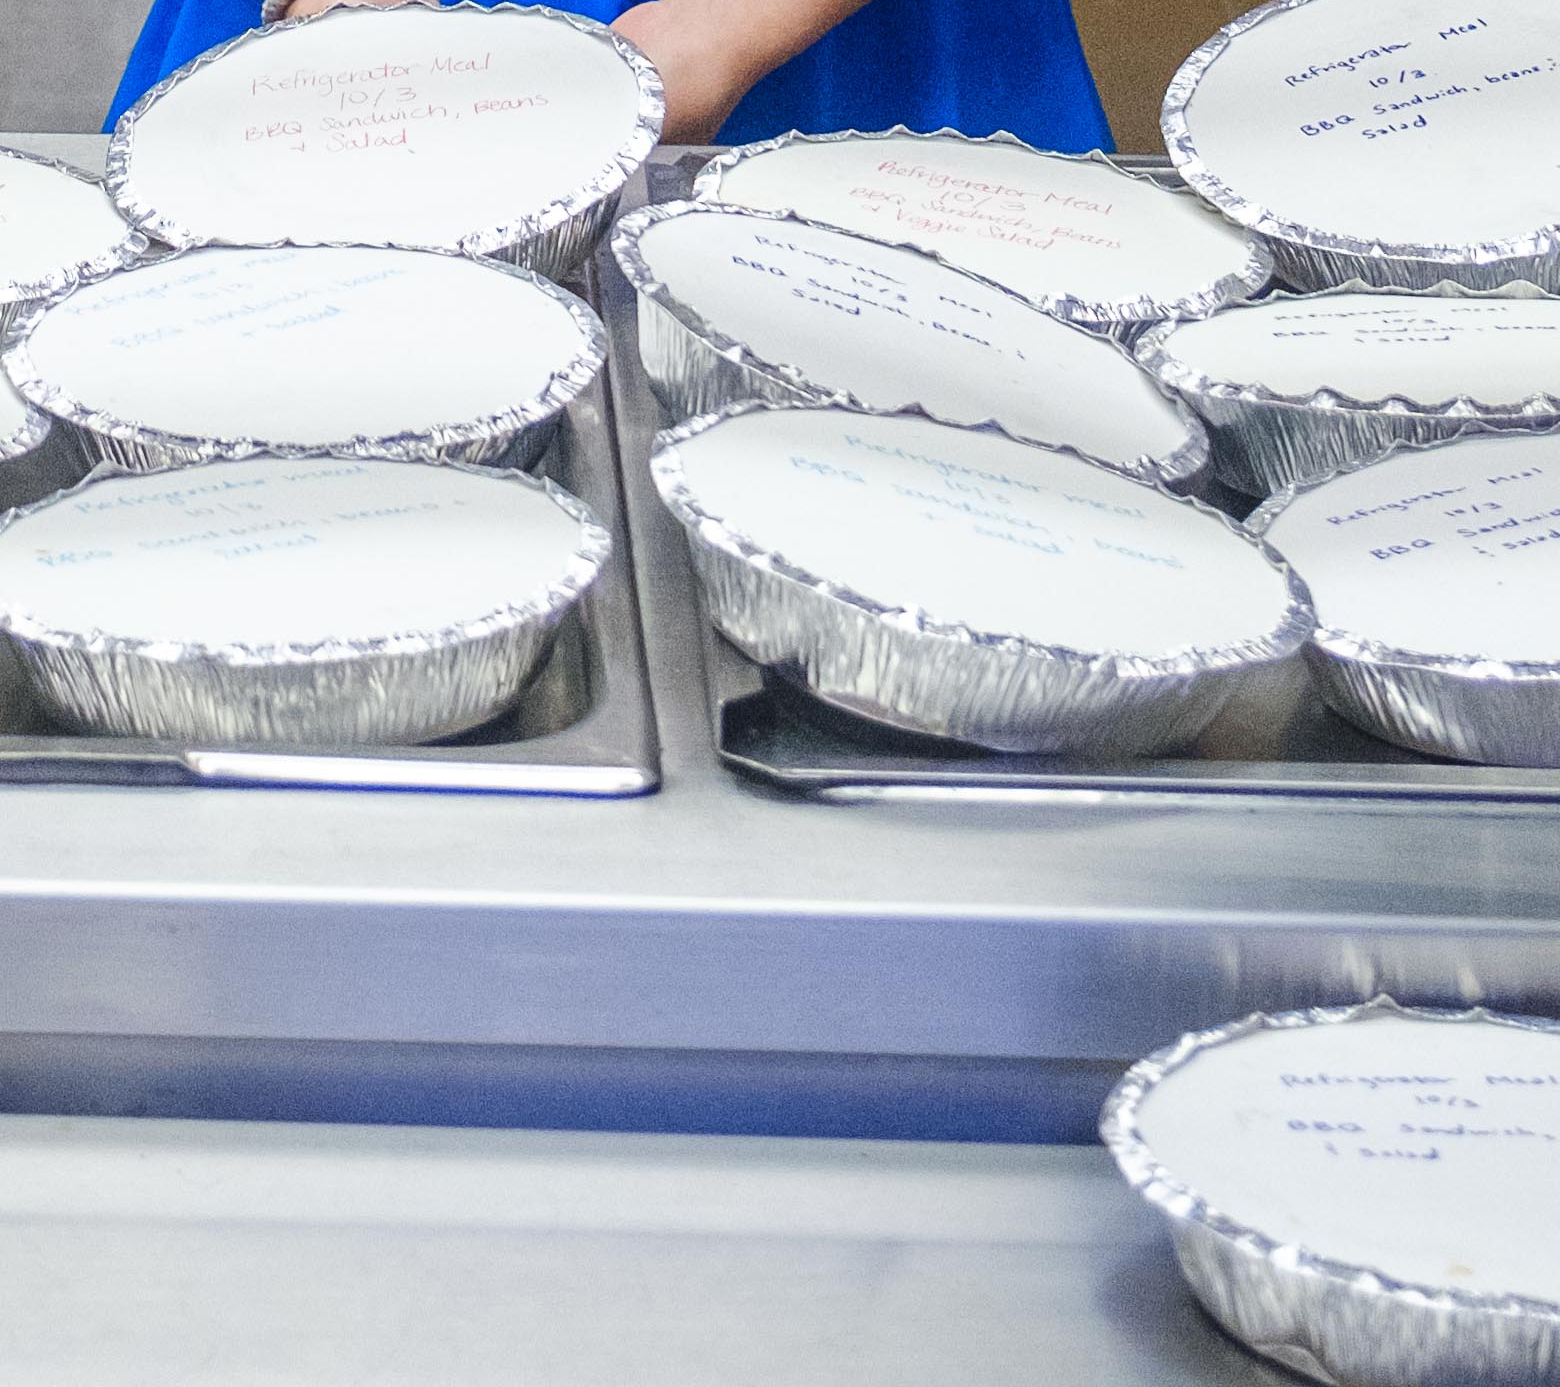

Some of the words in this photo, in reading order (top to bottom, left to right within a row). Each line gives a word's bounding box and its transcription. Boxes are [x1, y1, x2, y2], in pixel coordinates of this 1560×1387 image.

[251, 61, 421, 96] Refrigerator
[429, 52, 492, 74] Meal
[1284, 41, 1412, 88] Refrigerator
[339, 86, 418, 111] 10/3
[244, 120, 303, 142] BBQ
[1300, 114, 1356, 137] BBQ
[326, 128, 408, 152] Salad
[848, 186, 906, 206] BBQ
[876, 160, 1038, 198] Refrigerator
[1043, 191, 1114, 216] Meal
[940, 190, 1027, 212] 10/3
[895, 207, 968, 235] Veggie
[976, 226, 1055, 251] Salad
[1326, 486, 1467, 527] Refrigerator
[1369, 537, 1436, 562] BBQ
